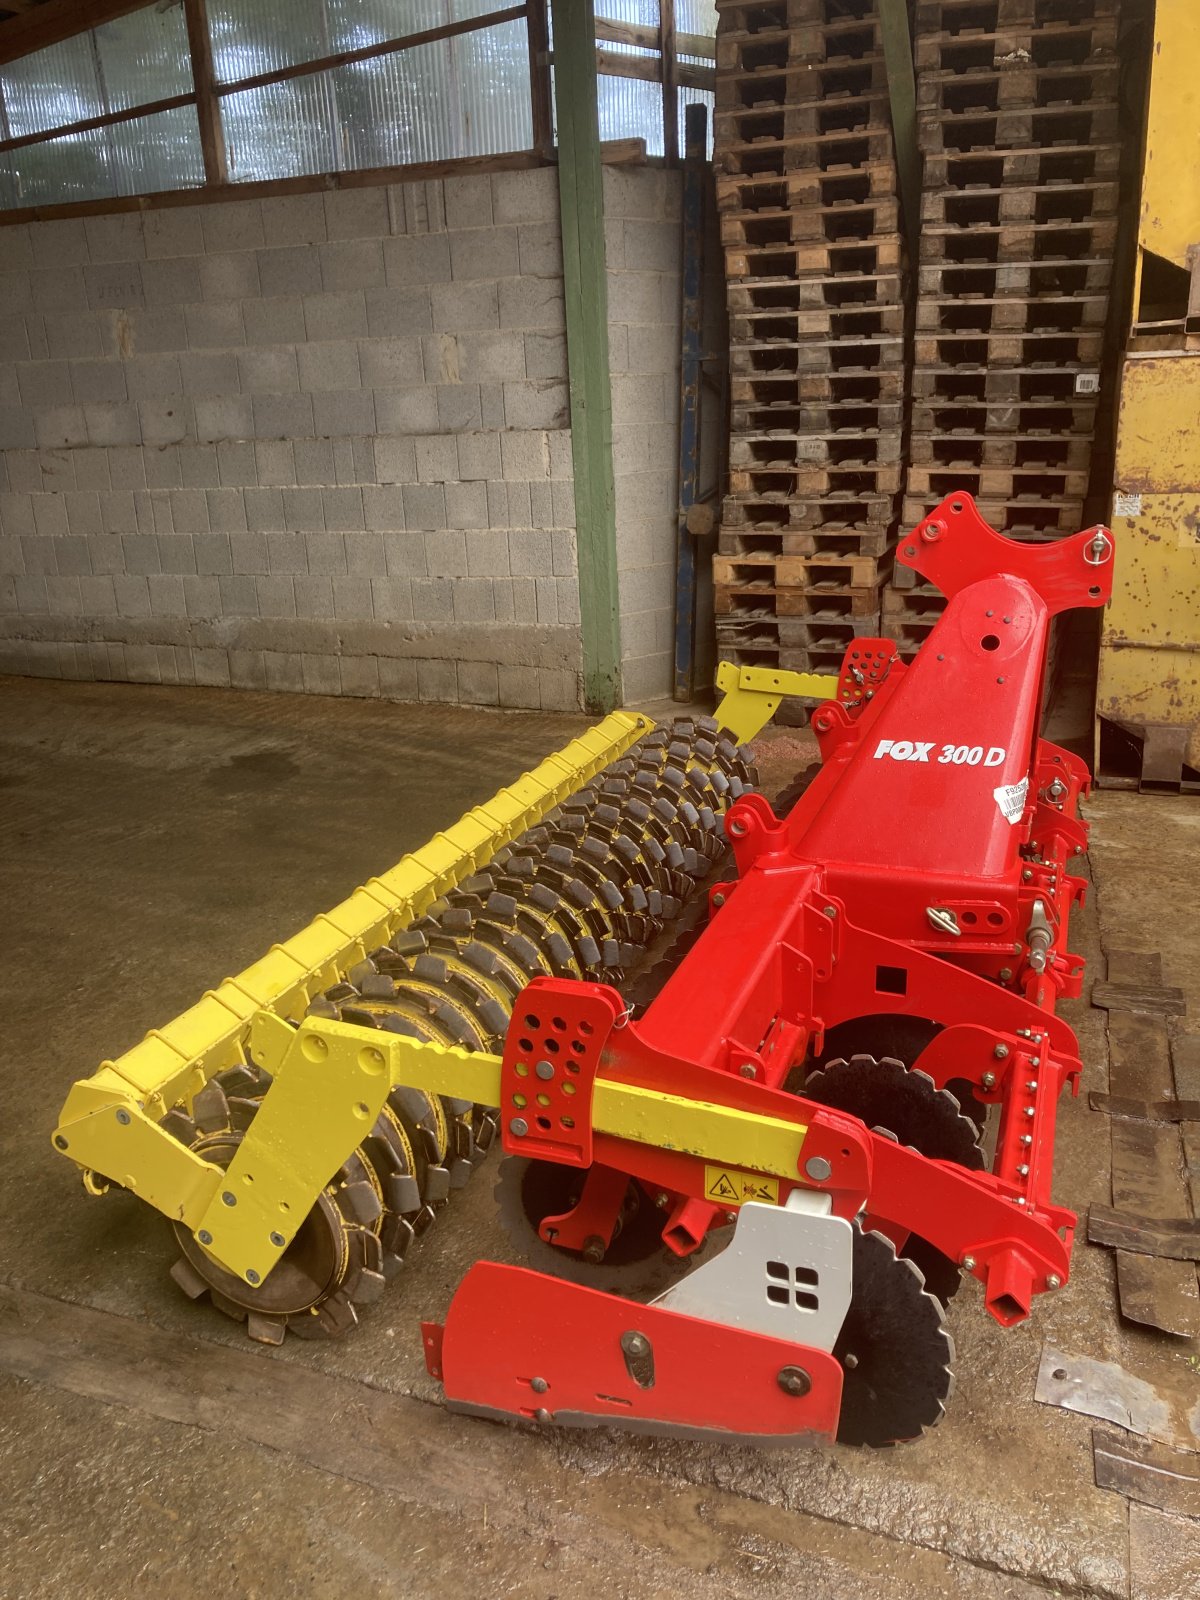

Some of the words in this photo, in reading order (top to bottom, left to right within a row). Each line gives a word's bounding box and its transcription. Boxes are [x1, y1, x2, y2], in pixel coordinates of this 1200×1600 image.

[873, 740, 936, 762] FOX
[938, 744, 984, 766] 300
[983, 747, 1006, 767] D
